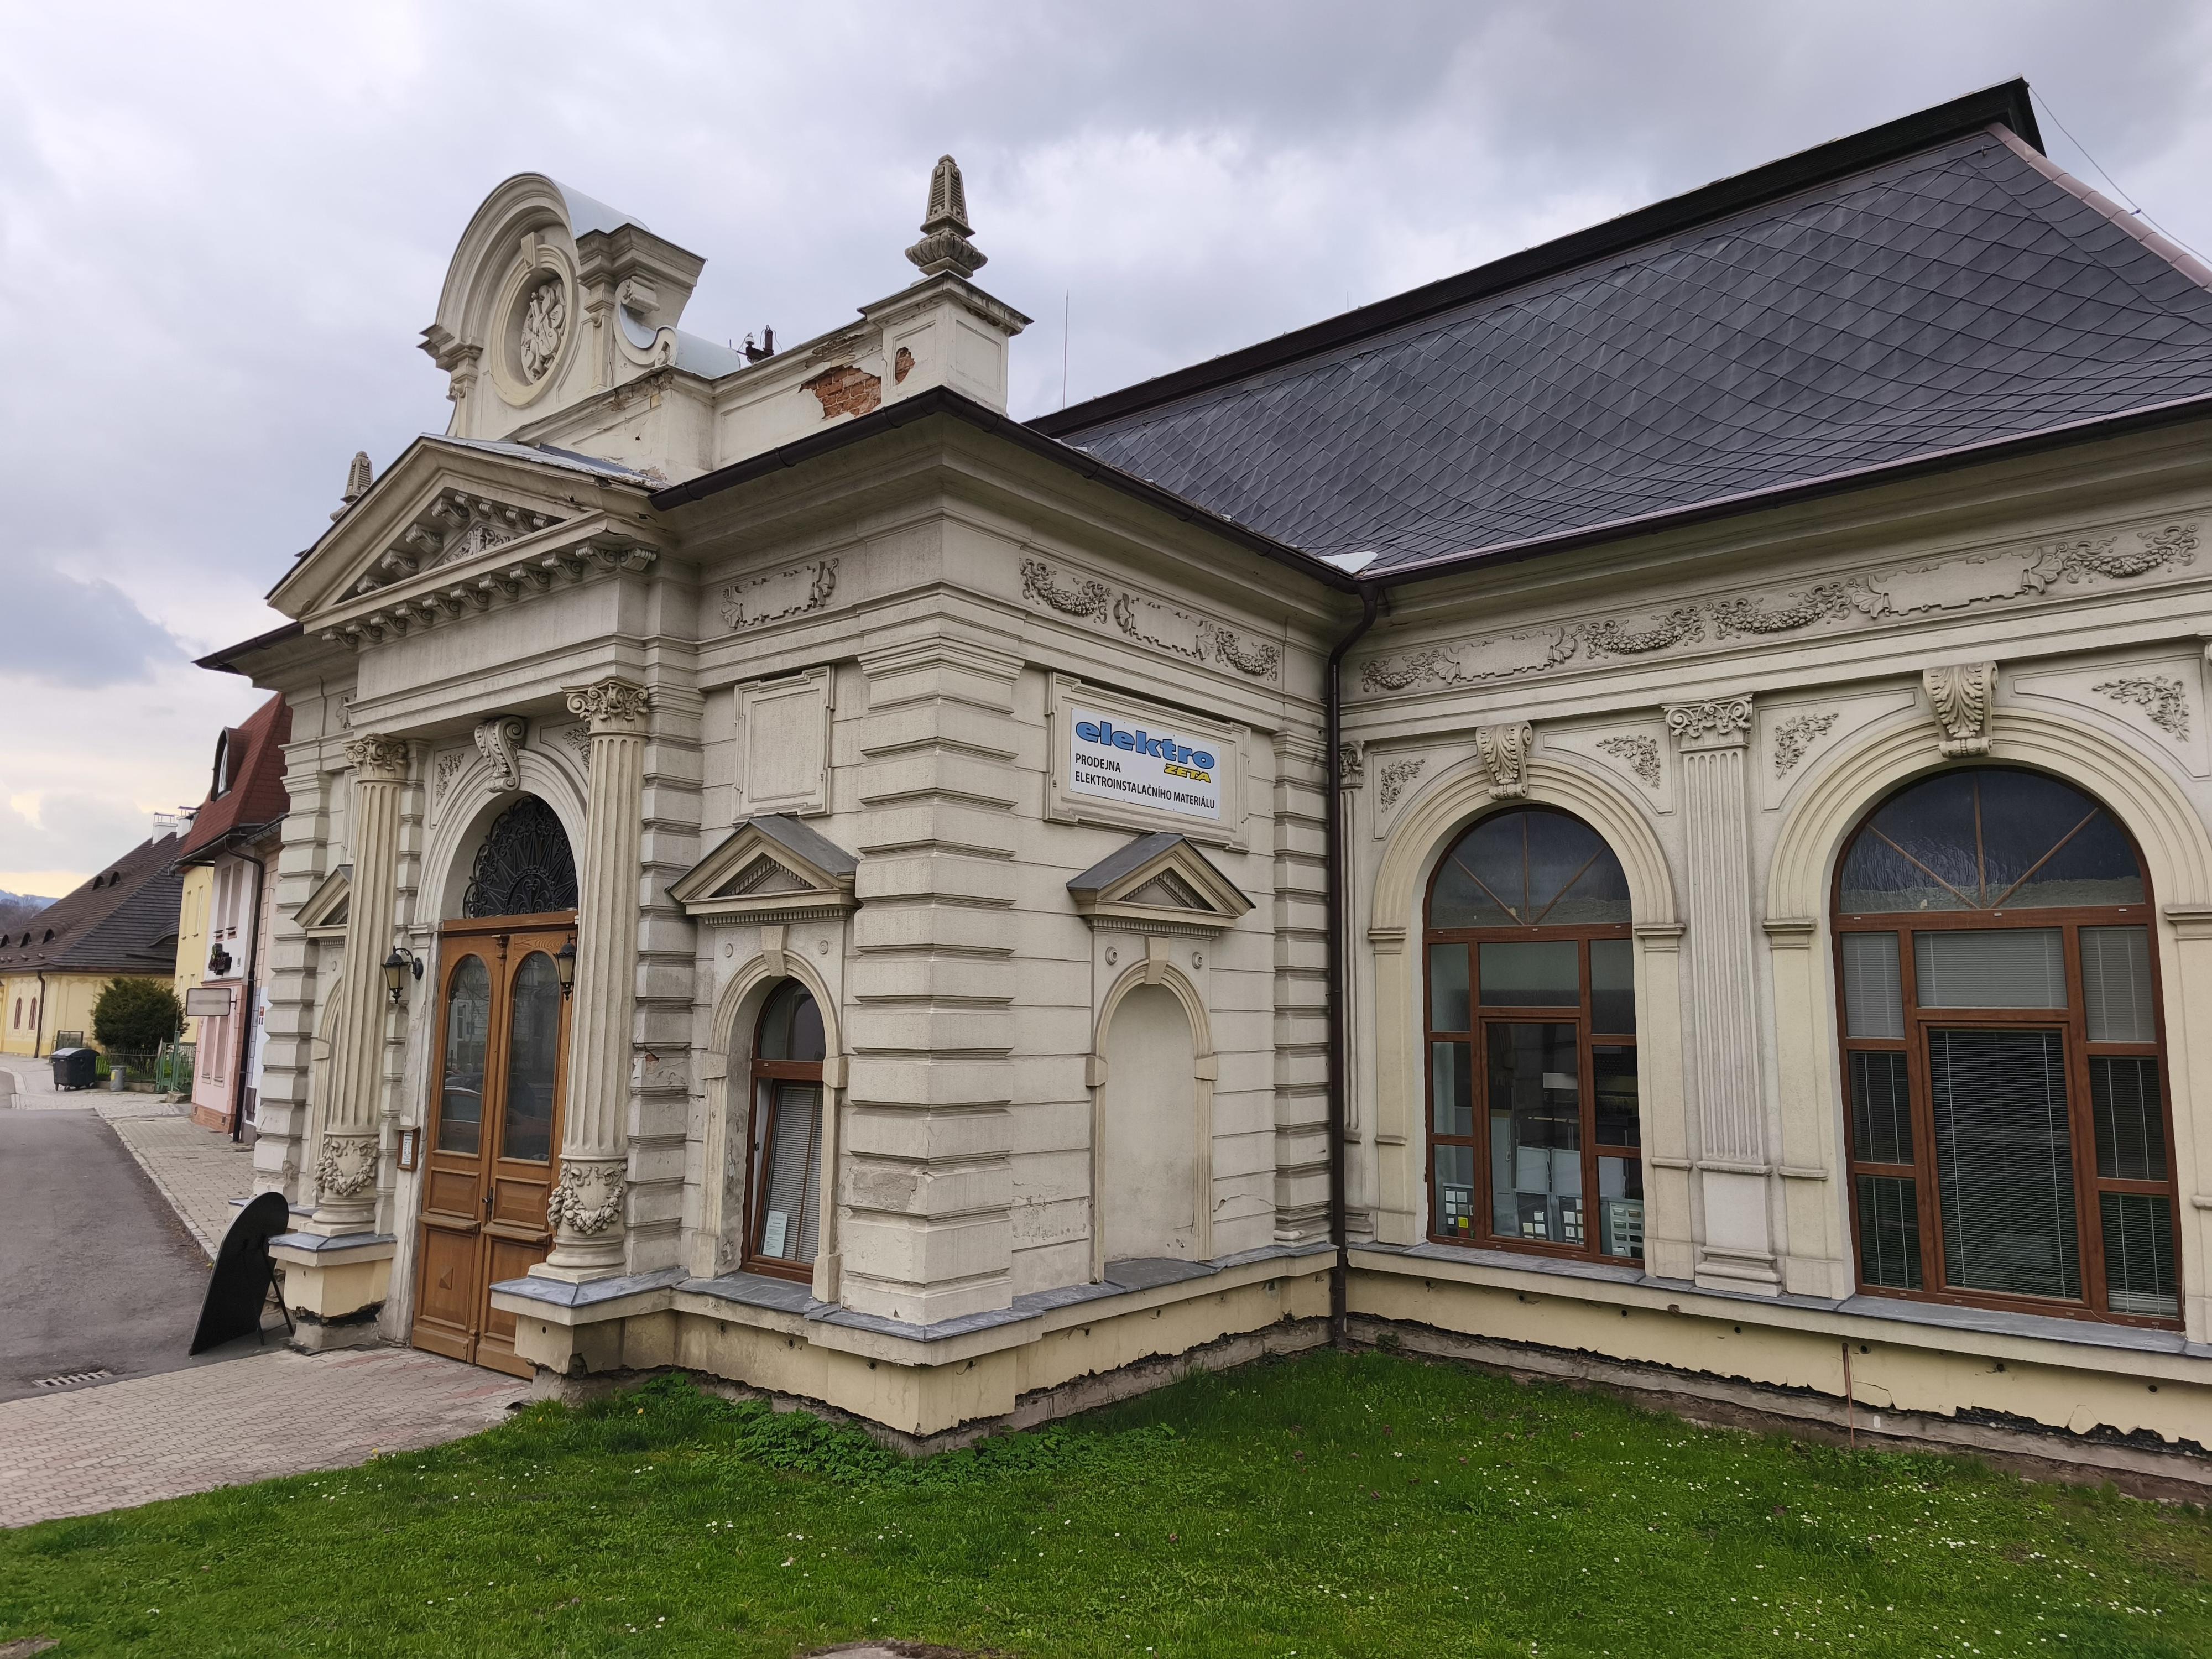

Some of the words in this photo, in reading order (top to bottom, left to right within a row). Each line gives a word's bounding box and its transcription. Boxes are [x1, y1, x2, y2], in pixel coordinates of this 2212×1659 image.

[1076, 721, 1215, 769] elektro
[1076, 753, 1121, 773] PRODEJNA
[1164, 763, 1211, 783] ZETA
[1075, 771, 1172, 800] ELEKTROINSTALAČNÍHO
[1173, 791, 1215, 808] MATERIÁLU
